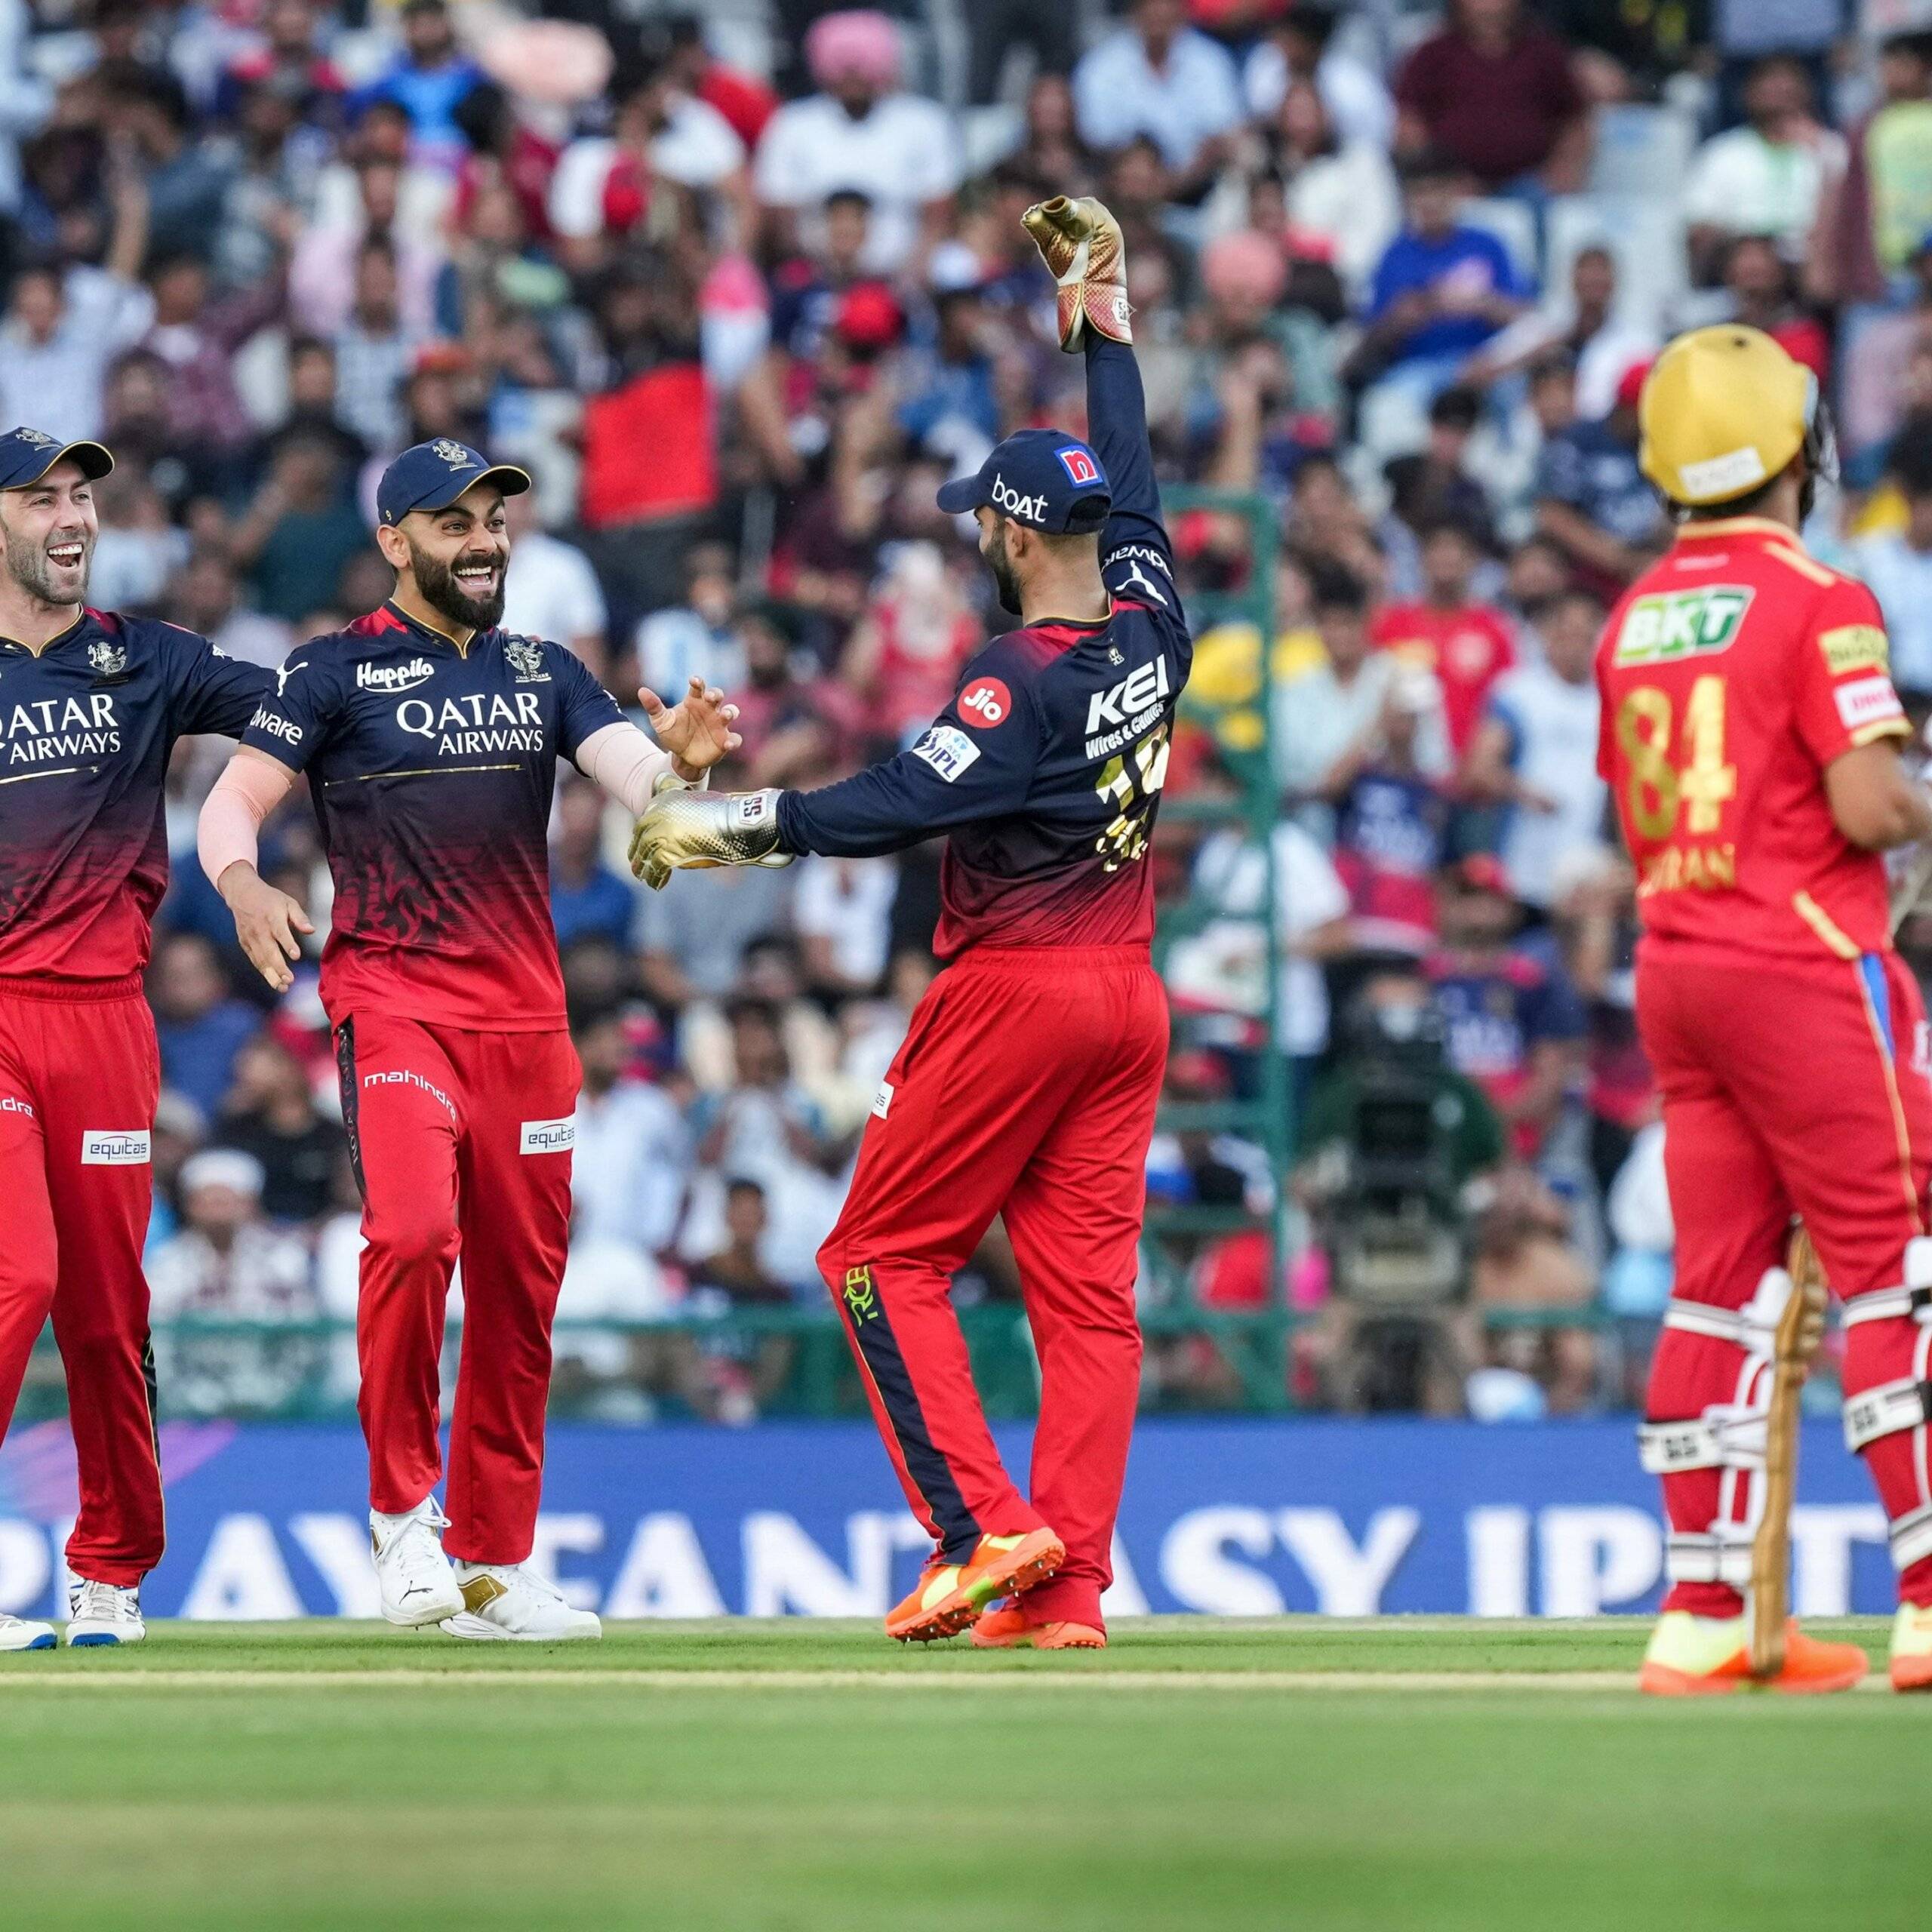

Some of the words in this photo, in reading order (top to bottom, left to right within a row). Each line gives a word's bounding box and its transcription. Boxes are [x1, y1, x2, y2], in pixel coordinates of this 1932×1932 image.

[1623, 599, 1744, 649] BKT
[357, 657, 435, 688] Happilo
[964, 688, 1002, 721] Jio
[1084, 653, 1170, 735] KEI
[0, 694, 118, 749] ATAR
[396, 693, 543, 739] QATAR
[10, 731, 121, 764] AIRWAYS
[438, 729, 543, 755] AIRWAYS
[1085, 735, 1124, 760] Wires
[1121, 724, 1134, 740] &
[1616, 674, 1737, 839] 84
[928, 747, 958, 778] IPL
[91, 1139, 146, 1160] equitas
